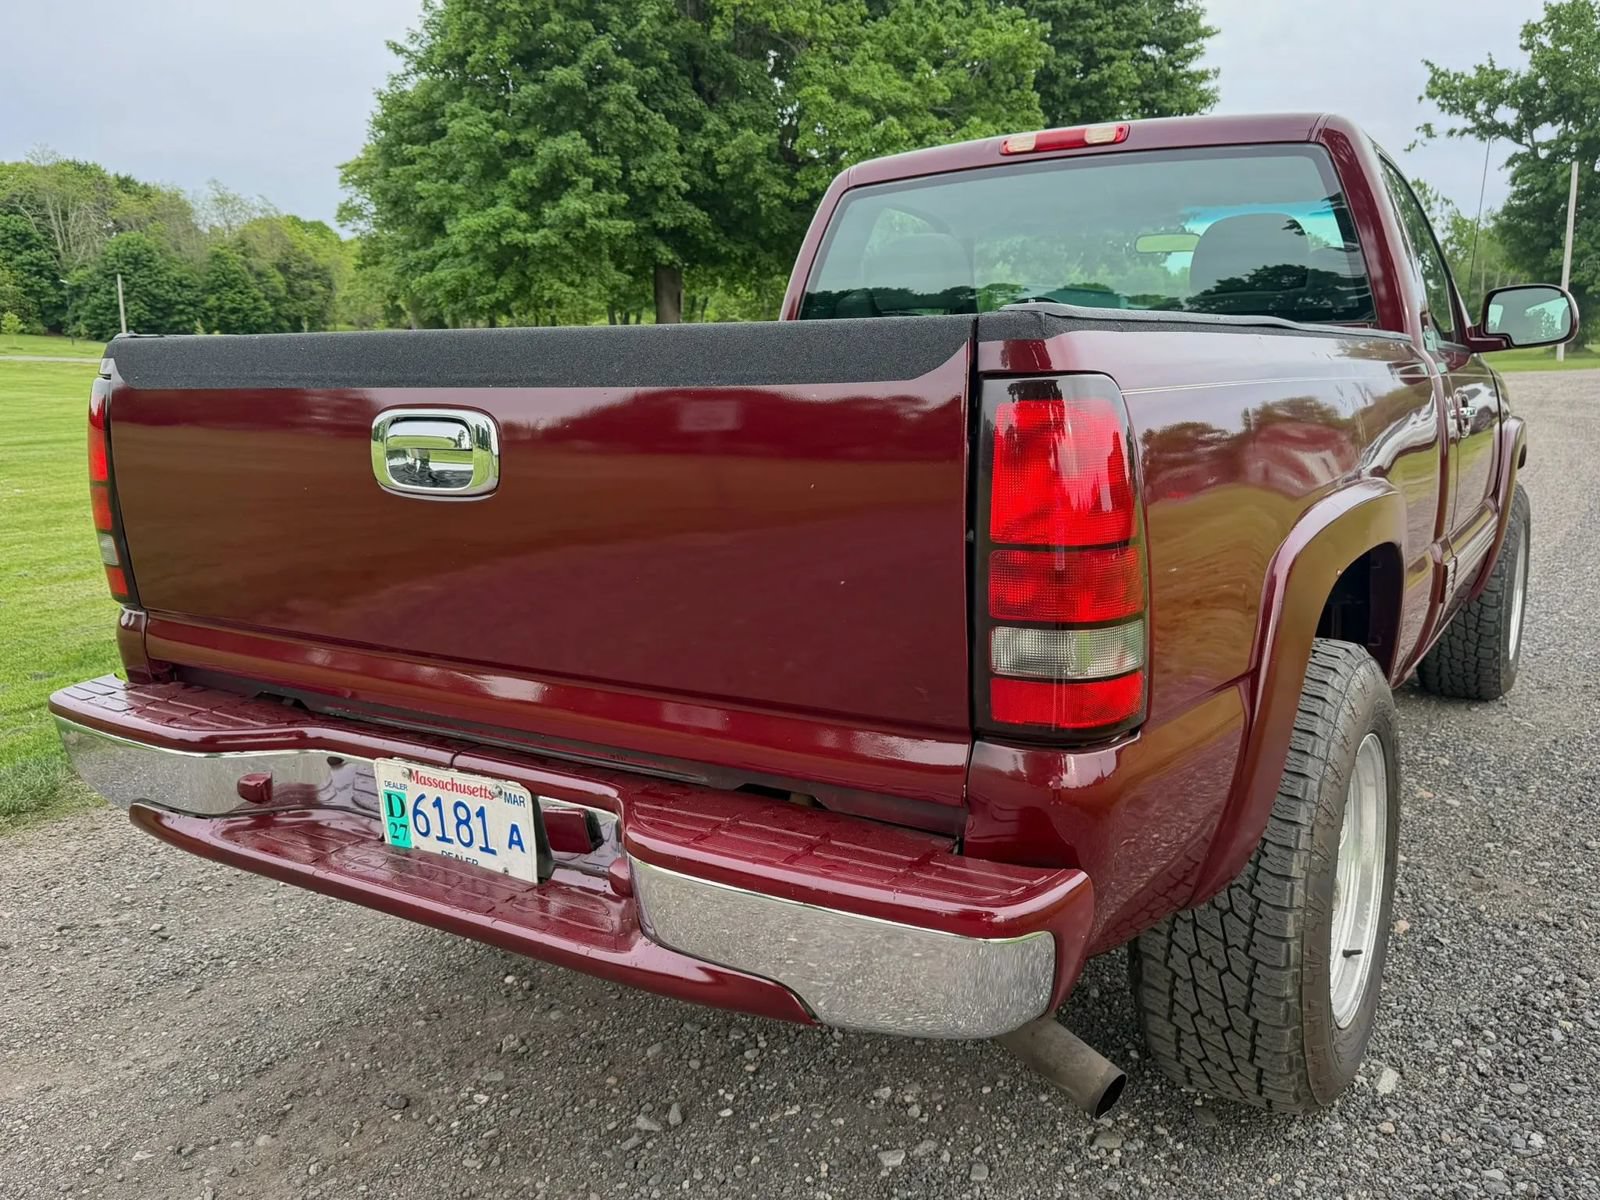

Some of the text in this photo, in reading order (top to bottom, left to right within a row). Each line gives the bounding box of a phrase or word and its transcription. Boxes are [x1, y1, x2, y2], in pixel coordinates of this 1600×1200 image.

[384, 780, 408, 791] DEALER
[409, 770, 495, 801] Massachusetts
[386, 792, 406, 819] D
[503, 791, 526, 808] MAR
[390, 821, 408, 842] 27
[412, 793, 526, 856] 6181 A
